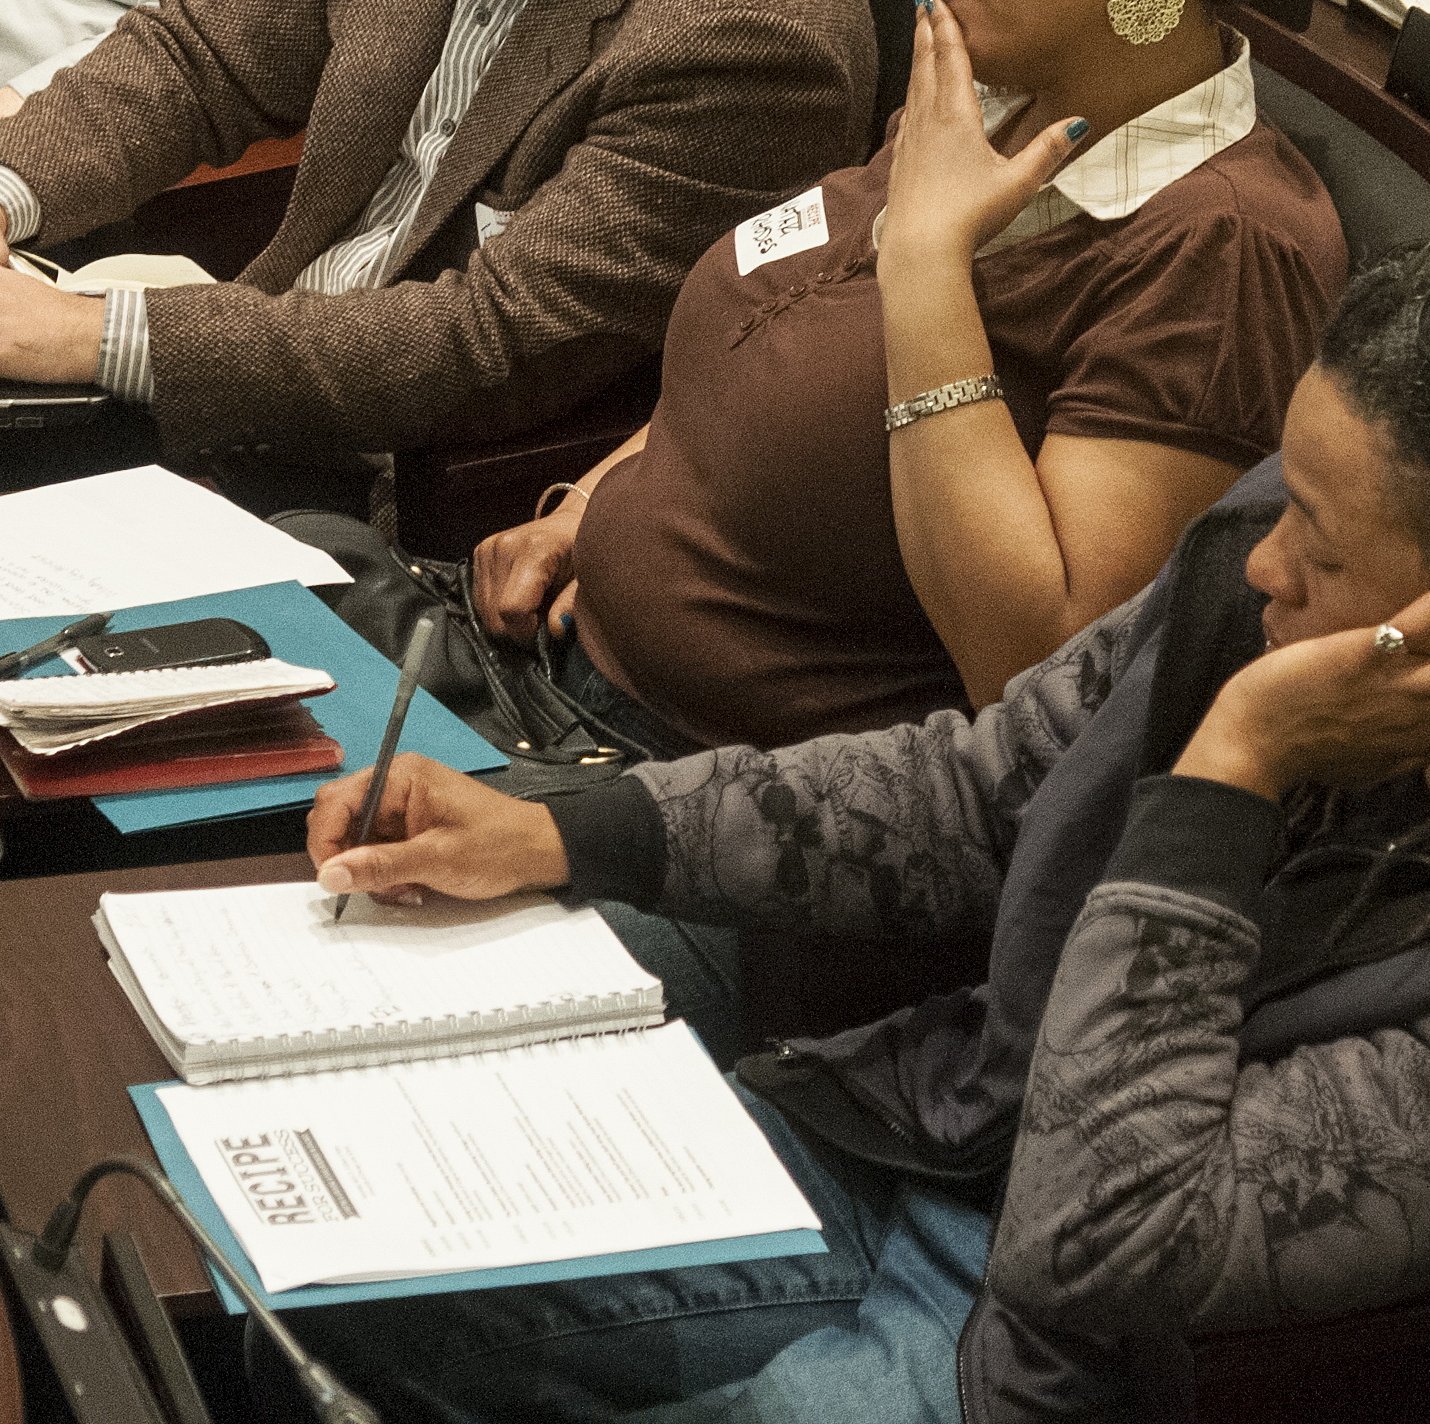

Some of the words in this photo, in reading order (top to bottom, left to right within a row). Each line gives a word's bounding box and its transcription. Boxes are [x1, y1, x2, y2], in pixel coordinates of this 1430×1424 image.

[221, 1133, 316, 1226] RECIPE
[273, 1128, 321, 1193] SUCCESS
[312, 1193, 339, 1223] FOR
